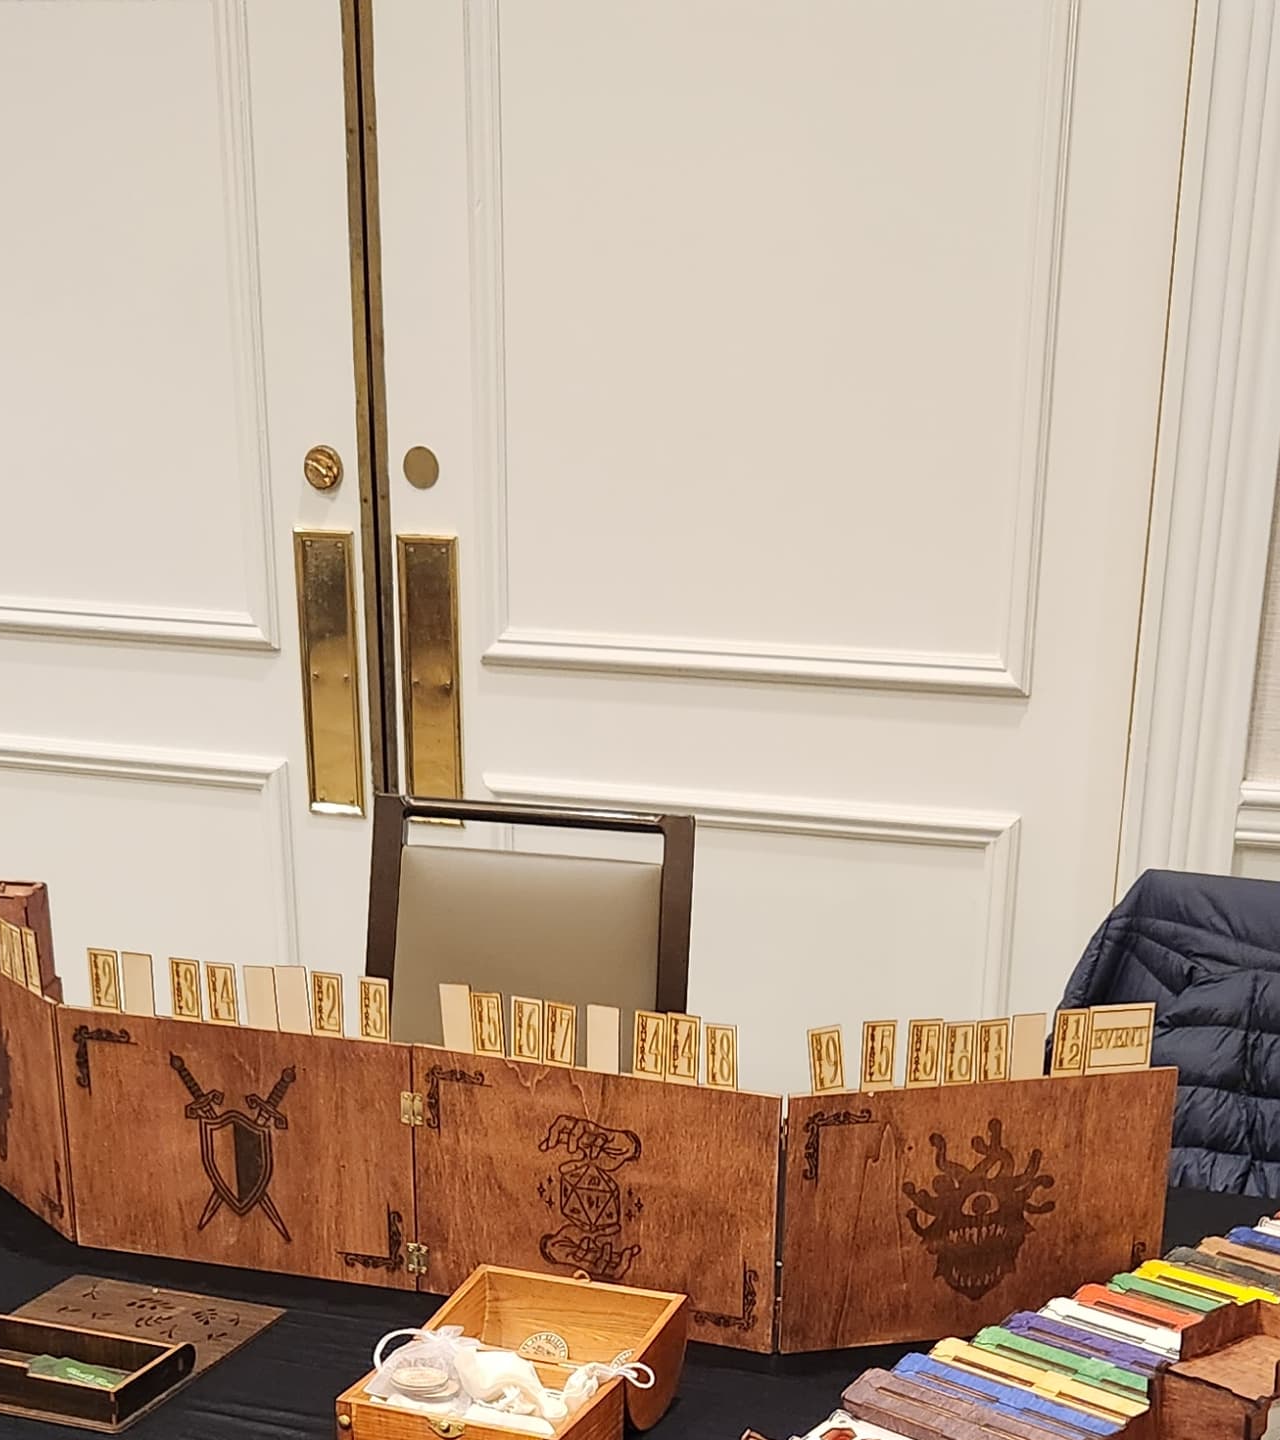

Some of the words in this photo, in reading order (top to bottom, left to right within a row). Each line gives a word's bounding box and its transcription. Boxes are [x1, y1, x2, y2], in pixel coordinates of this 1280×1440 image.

[102, 958, 116, 1003] 2
[184, 967, 195, 1013] 3
[220, 971, 234, 1016] 4
[326, 980, 338, 1025] 2
[373, 988, 384, 1034] 3
[487, 1000, 498, 1047] 5
[526, 1007, 537, 1055] 6
[559, 1010, 571, 1059] 7
[648, 1021, 662, 1070] 4
[681, 1025, 694, 1073] 4
[720, 1031, 732, 1082] 8
[826, 1035, 839, 1083] 9
[878, 1029, 892, 1077] 5
[923, 1029, 937, 1077] 5
[1091, 1026, 1148, 1049] EVENT
